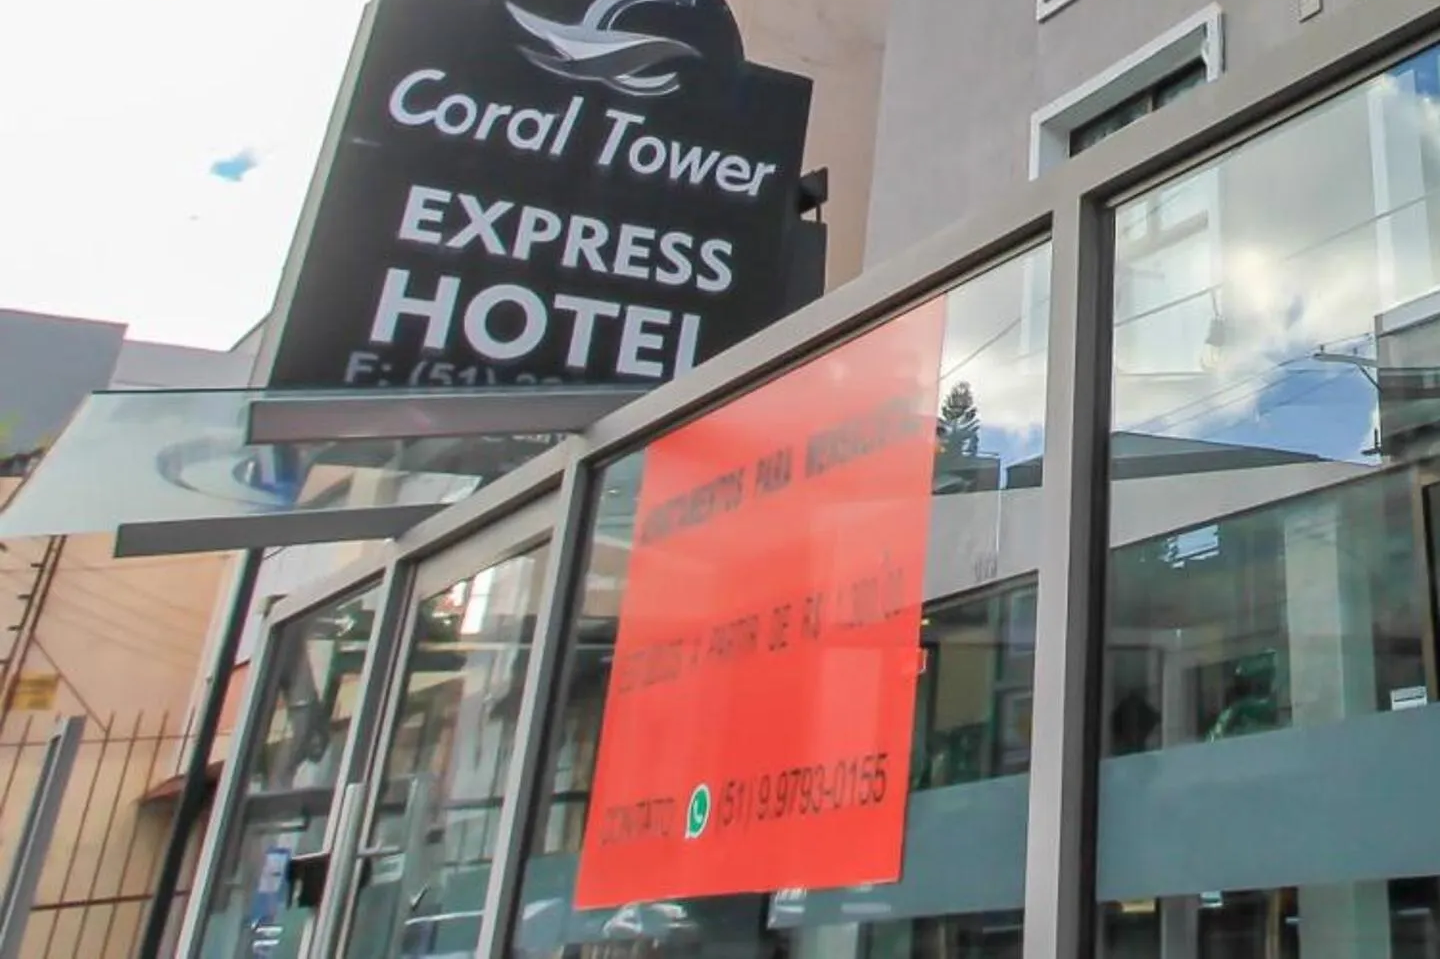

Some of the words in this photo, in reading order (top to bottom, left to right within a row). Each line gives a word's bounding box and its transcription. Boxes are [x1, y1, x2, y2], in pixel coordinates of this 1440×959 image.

[388, 68, 584, 155] Coral
[596, 108, 777, 197] Tower
[398, 184, 733, 293] EXPRESS
